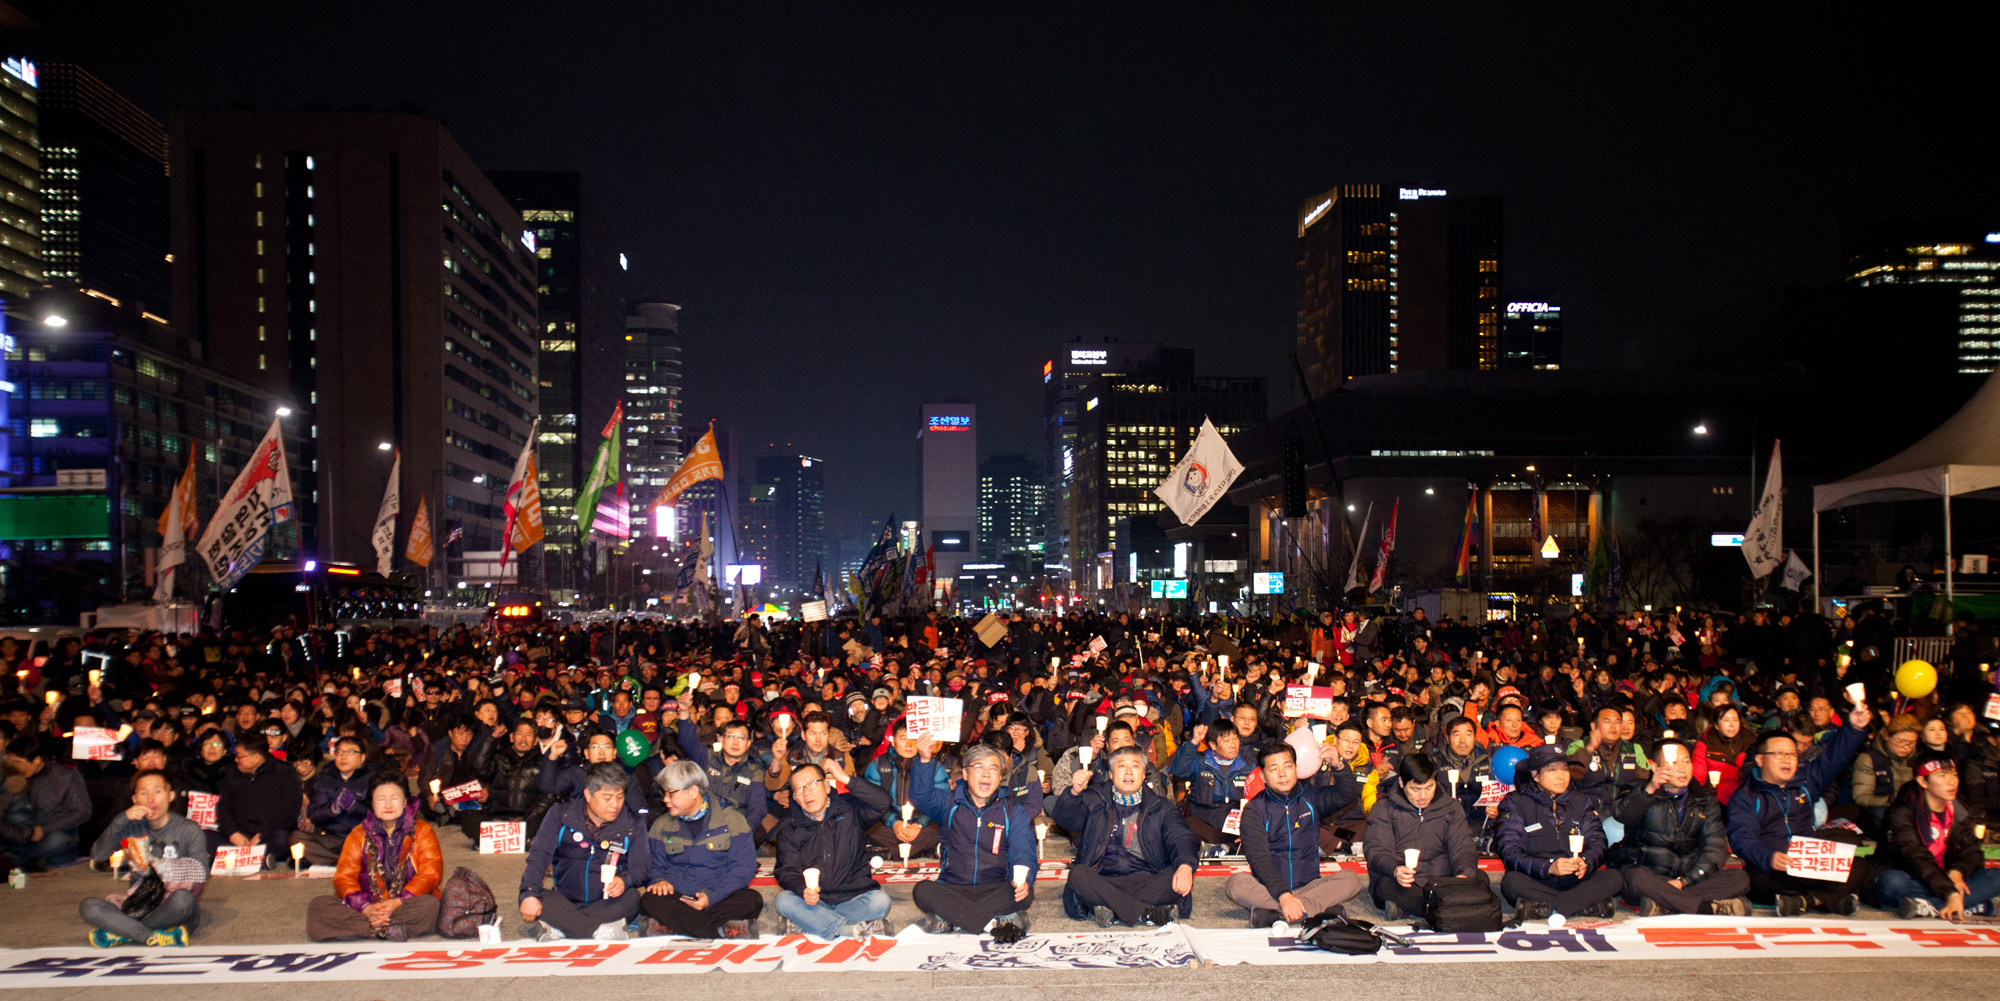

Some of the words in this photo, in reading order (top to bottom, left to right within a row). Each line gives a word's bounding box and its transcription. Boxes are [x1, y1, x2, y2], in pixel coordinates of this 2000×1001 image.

[1507, 302, 1548, 313] OFFICIA
[928, 416, 971, 425] 조선일보
[906, 697, 944, 716] 박근혜
[908, 715, 961, 734] 즉각퇴진
[480, 821, 520, 839] 박근혜
[493, 837, 520, 854] 퇴진
[1788, 840, 1836, 855] 박근혜
[1789, 857, 1852, 872] 즉각퇴진
[0, 952, 374, 978] 박근혜
[378, 944, 630, 971] 정책
